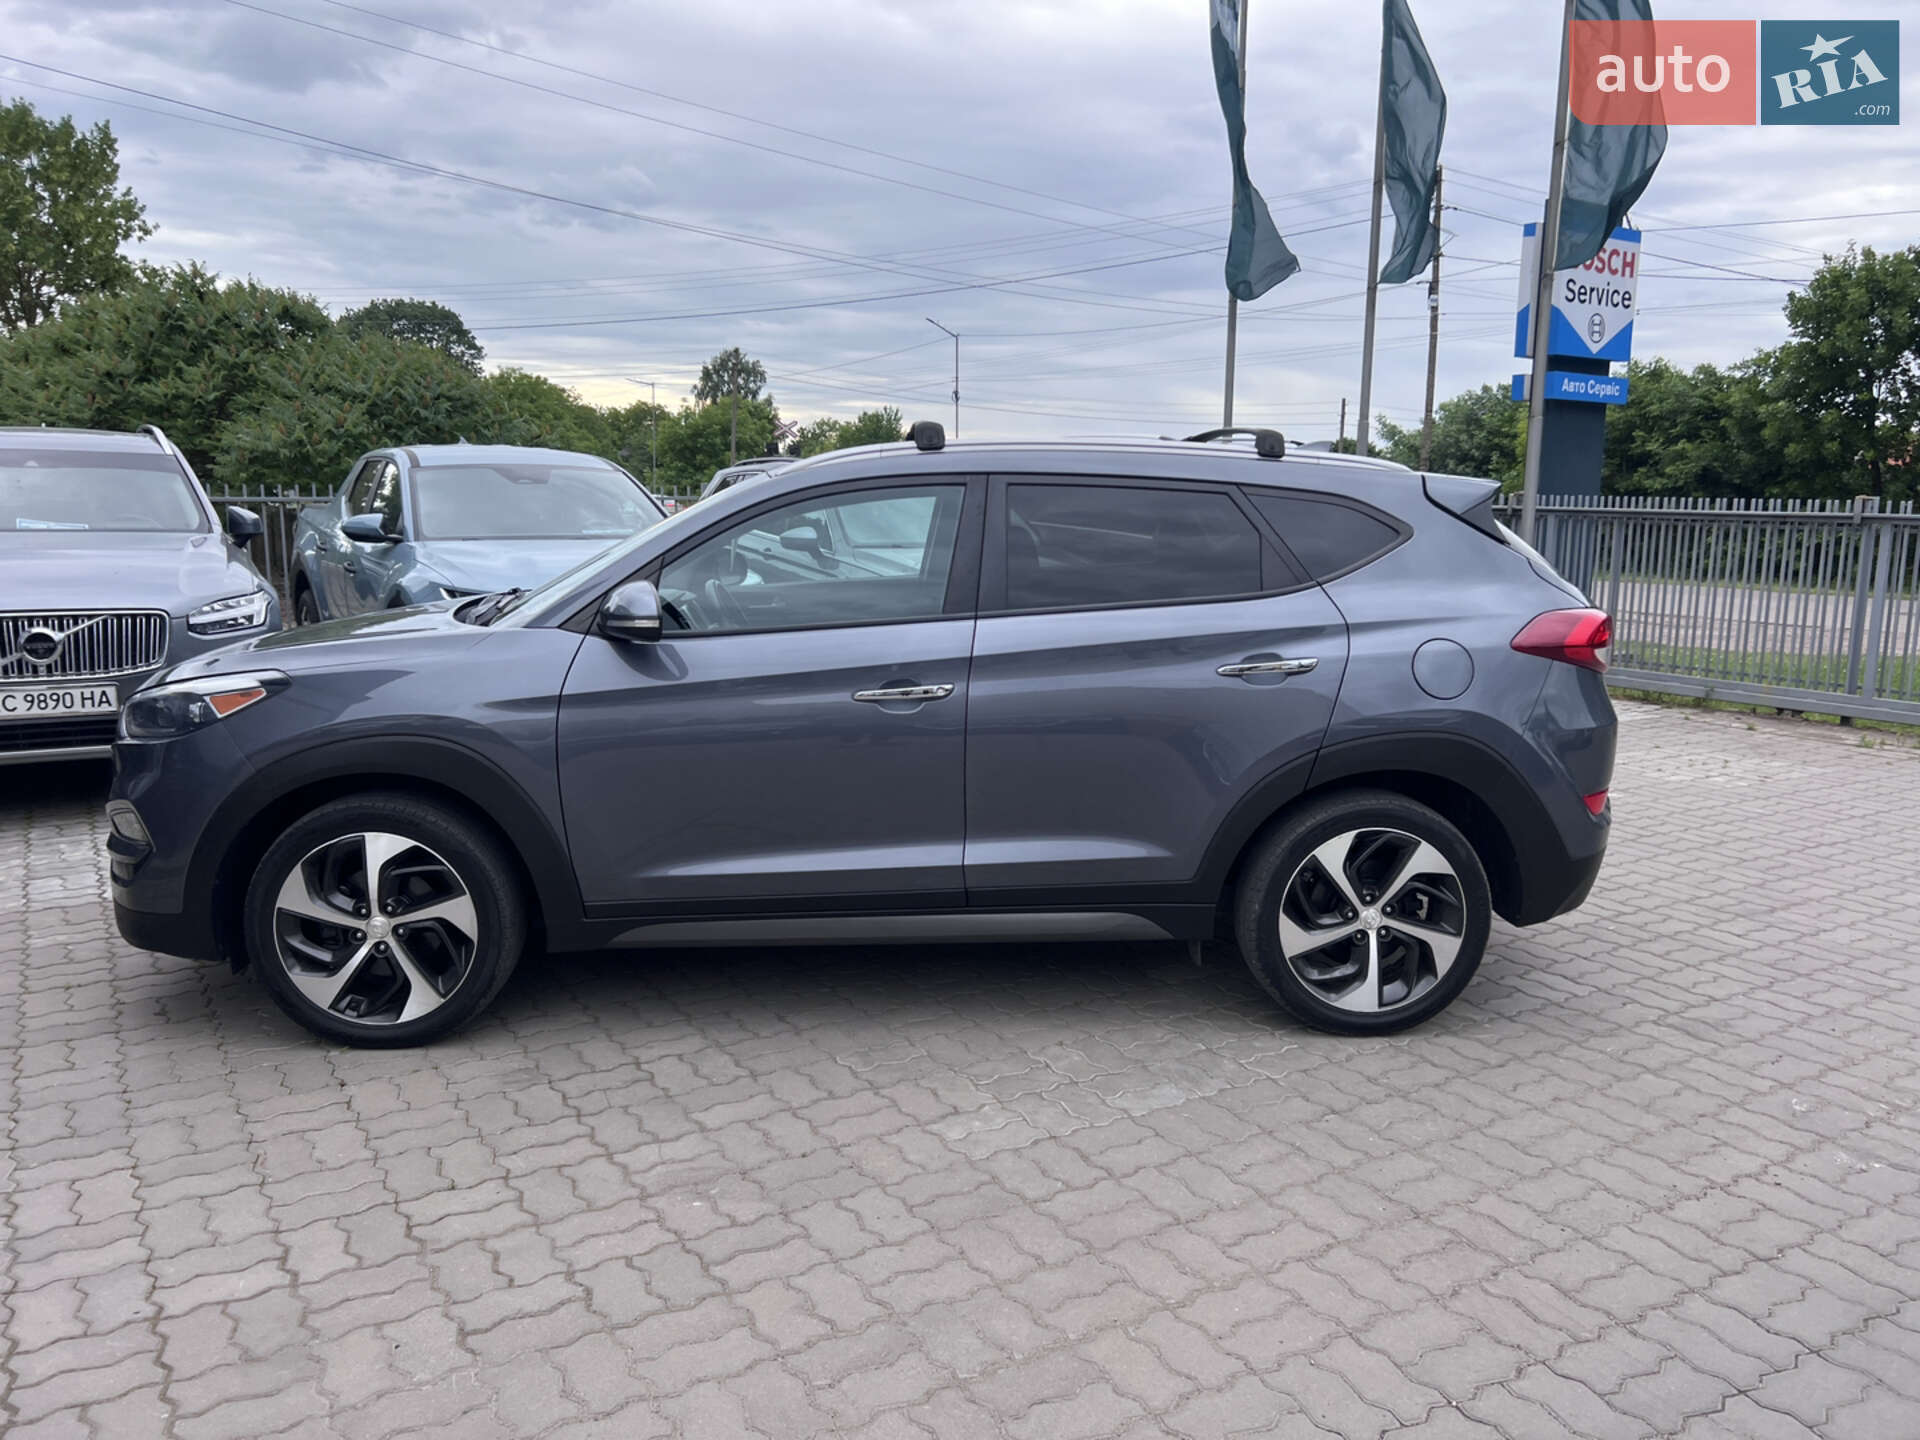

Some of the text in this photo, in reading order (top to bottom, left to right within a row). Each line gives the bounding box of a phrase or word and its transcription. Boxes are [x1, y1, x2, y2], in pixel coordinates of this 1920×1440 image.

[1576, 248, 1636, 278] SCH
[1564, 278, 1632, 309] Service
[1561, 377, 1620, 398] Авто Сервіс
[23, 691, 75, 711] 9890
[80, 690, 112, 708] HA
